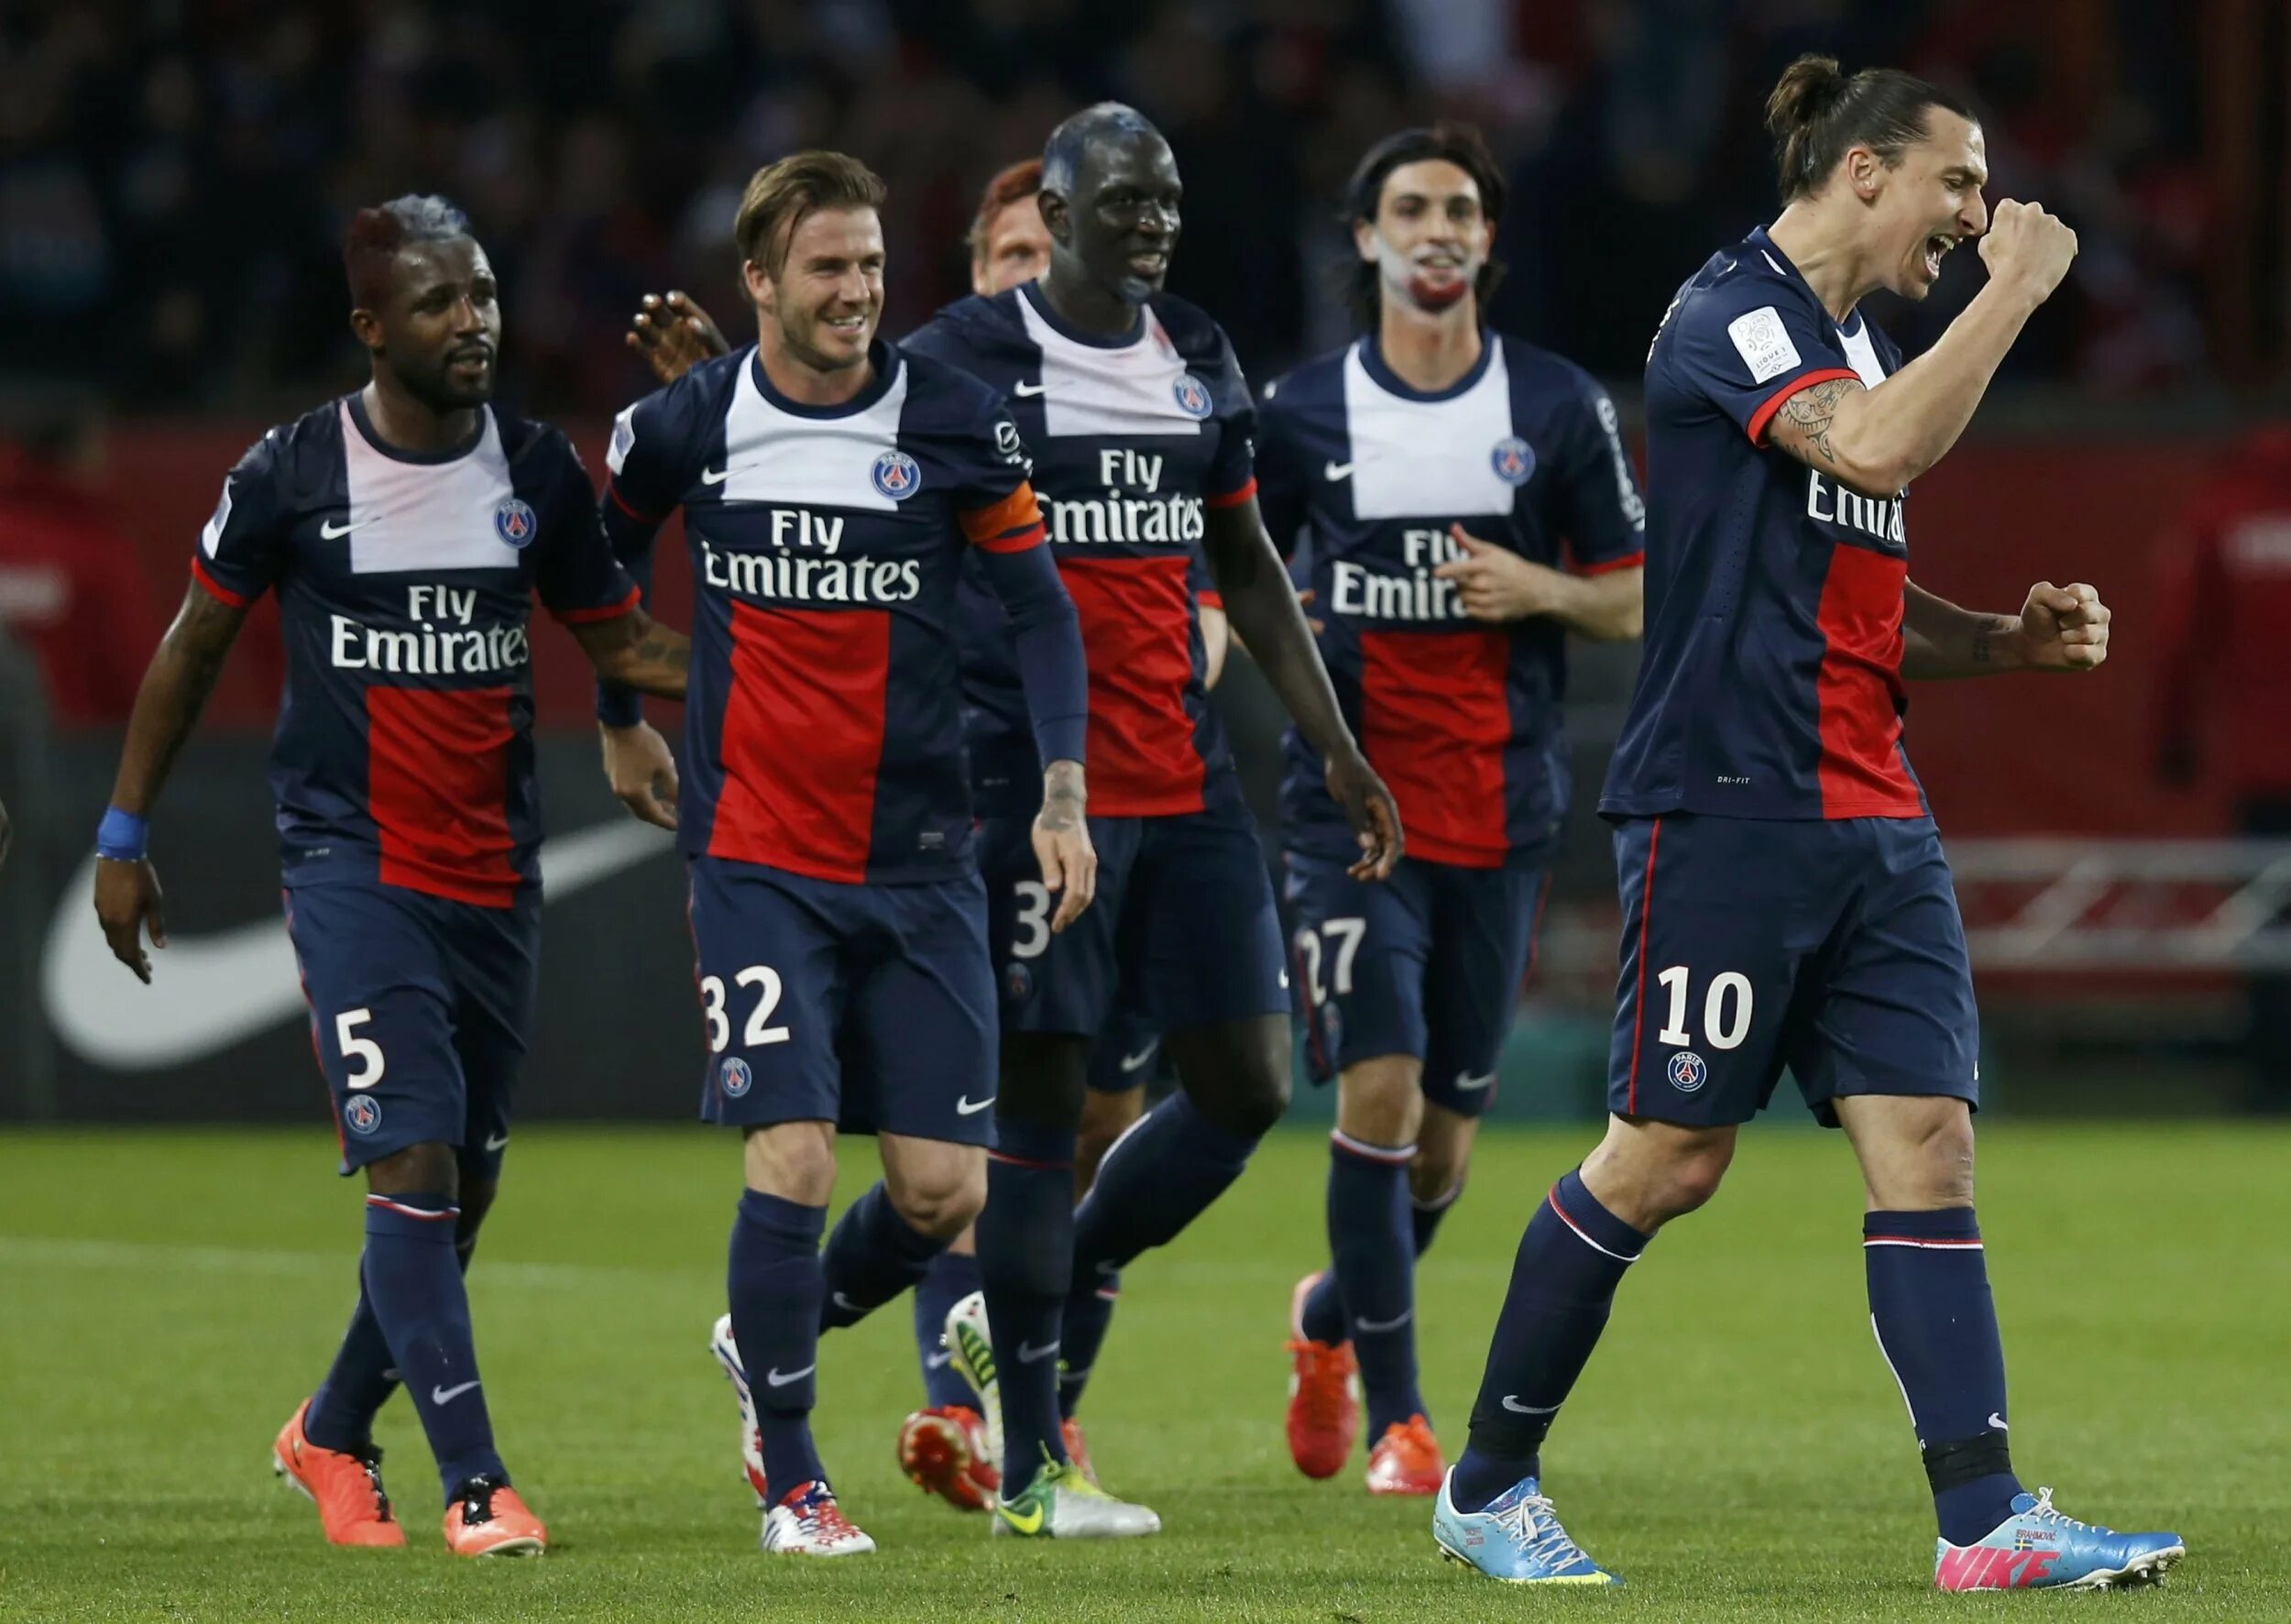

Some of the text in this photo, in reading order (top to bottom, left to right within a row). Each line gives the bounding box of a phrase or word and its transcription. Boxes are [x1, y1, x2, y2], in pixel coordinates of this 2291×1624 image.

[1100, 448, 1163, 493] Fly
[771, 510, 845, 554] Fly
[701, 541, 920, 603] Emirates
[408, 585, 477, 625] Fly
[330, 614, 530, 675] Emirates
[1716, 775, 1751, 785] DRI-FIT
[1012, 881, 1050, 959] 3
[700, 965, 790, 1053] 32
[1657, 966, 1754, 1049] 10
[335, 1008, 385, 1090] 5
[1675, 1054, 1701, 1066] PARIS
[1935, 1546, 2061, 1593] NIKE
